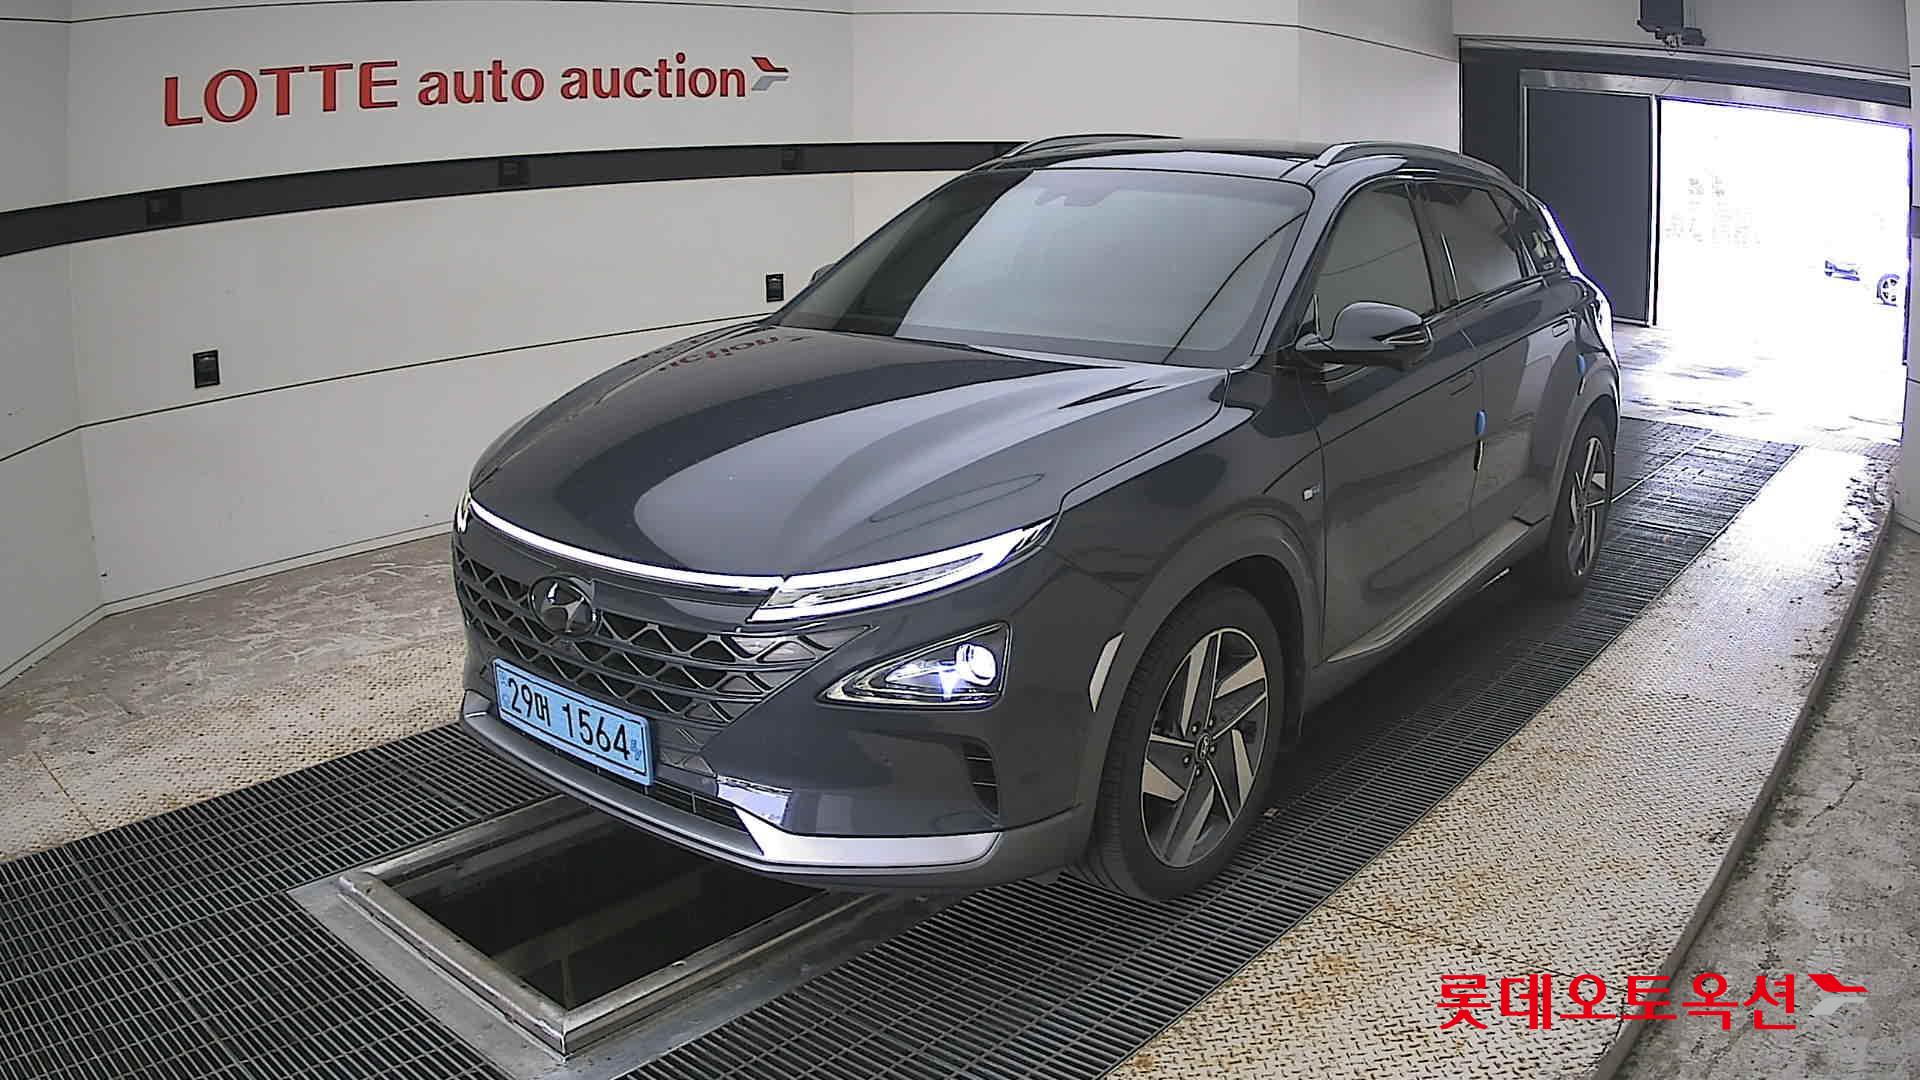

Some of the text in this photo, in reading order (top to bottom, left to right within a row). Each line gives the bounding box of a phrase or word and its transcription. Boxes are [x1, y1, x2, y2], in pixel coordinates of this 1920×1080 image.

[164, 53, 746, 126] LOTTE auto auction
[508, 677, 551, 727] 29머
[562, 703, 631, 762] 1564
